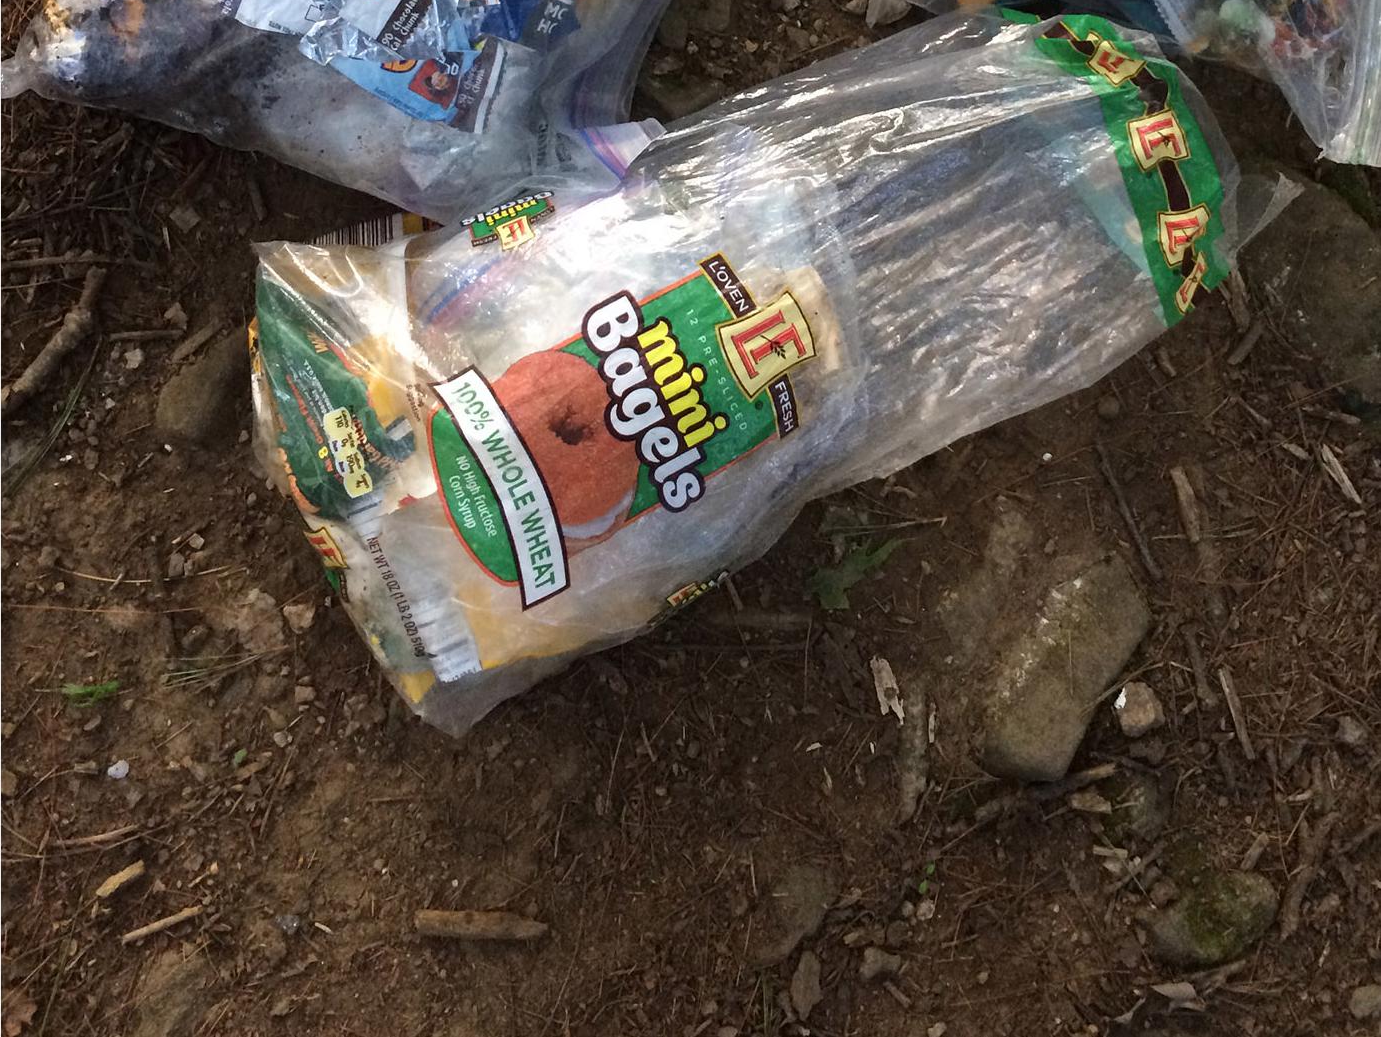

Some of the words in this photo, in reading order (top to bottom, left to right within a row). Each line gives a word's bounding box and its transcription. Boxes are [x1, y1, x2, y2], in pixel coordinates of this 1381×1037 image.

[382, 32, 394, 46] 90
[389, 38, 402, 52] Cal
[400, 11, 420, 36] Chunk
[708, 259, 750, 314] L'OVEN
[773, 380, 795, 434] FRESH
[686, 307, 700, 328] 12
[697, 333, 748, 432] PRE-SLICED
[636, 319, 728, 449] mini
[585, 294, 703, 510] Bagels
[334, 415, 344, 429] 110
[317, 445, 330, 460] 8
[455, 454, 471, 472] NO
[452, 380, 496, 433] 100%
[481, 428, 537, 512] WHOLE
[521, 507, 557, 590] WHEAT
[462, 470, 482, 496] High
[448, 474, 466, 500] Corn
[457, 495, 478, 531] Syrup
[473, 487, 498, 539] Fructose
[366, 536, 383, 555] NET
[373, 555, 390, 570] WT
[381, 568, 393, 581] 18
[386, 579, 401, 593] OZ
[396, 598, 411, 614] LB
[401, 613, 413, 623] 2
[403, 620, 419, 638] OZ)
